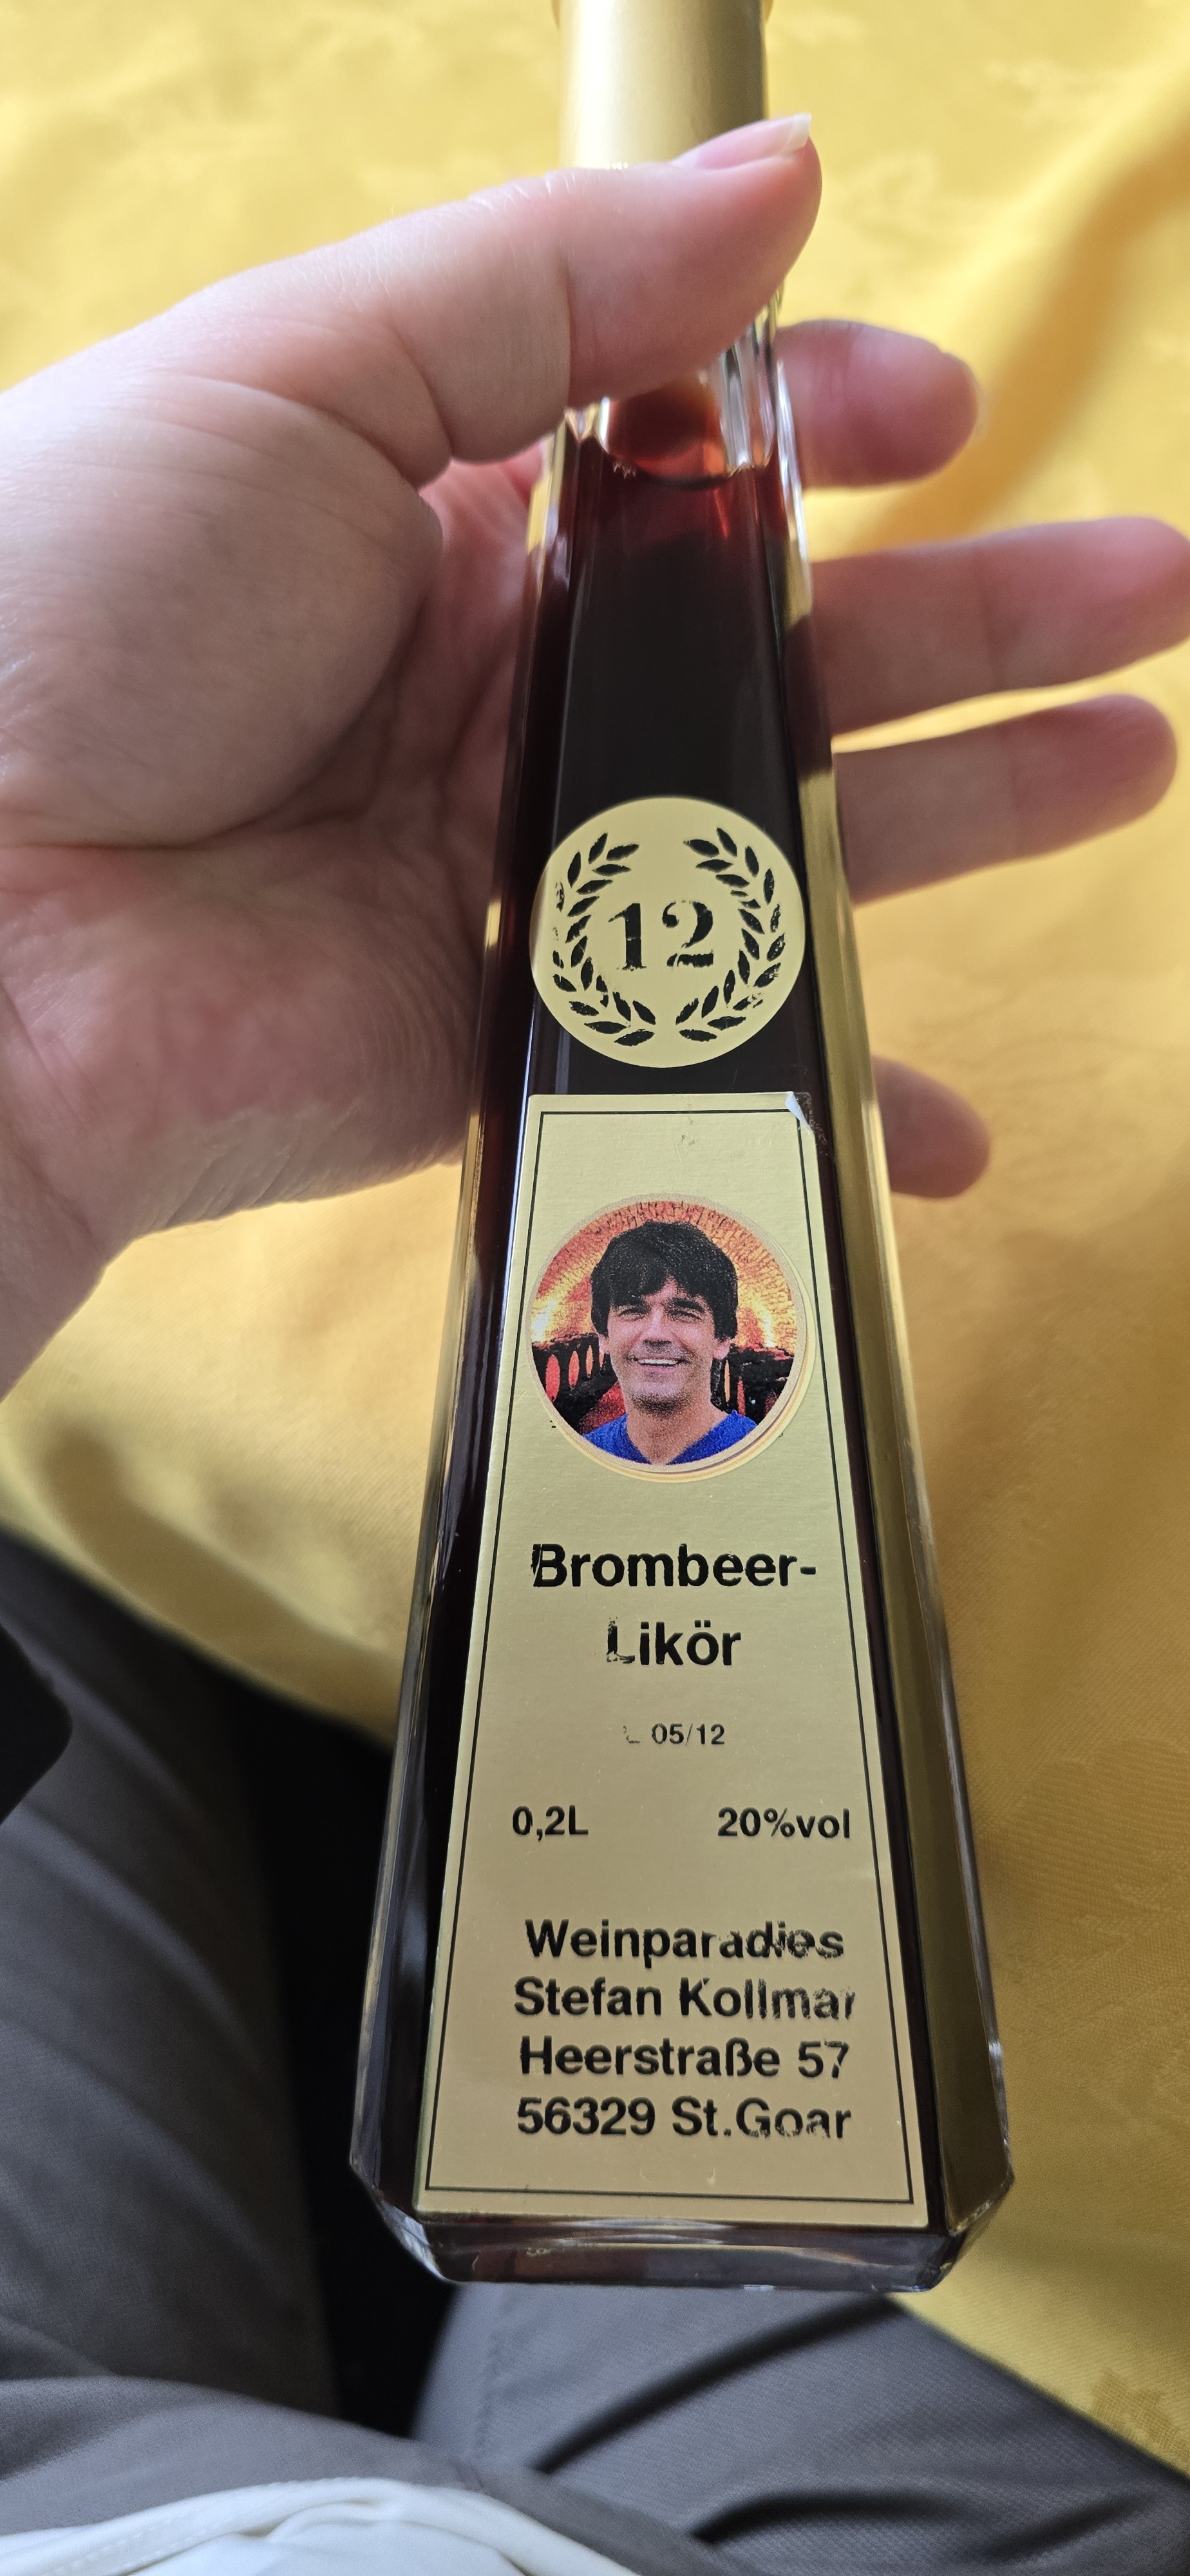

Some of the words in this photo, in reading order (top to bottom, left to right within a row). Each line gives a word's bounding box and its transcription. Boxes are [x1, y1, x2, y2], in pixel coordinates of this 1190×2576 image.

[608, 901, 713, 971] 12
[531, 1543, 816, 1587] Brombeer-
[606, 1618, 741, 1665] Likör
[651, 1723, 725, 1745] 05/12
[512, 1804, 589, 1841] 0,2L
[718, 1806, 850, 1839] 20%vol
[525, 1918, 844, 1968] Weinparadies
[515, 1976, 662, 2015] Stefan
[679, 1977, 855, 2020] Kollmar
[520, 2035, 780, 2076] Heerstraße
[798, 2040, 849, 2078] 57
[517, 2097, 656, 2135] 56329
[672, 2096, 851, 2139] St.Goar
